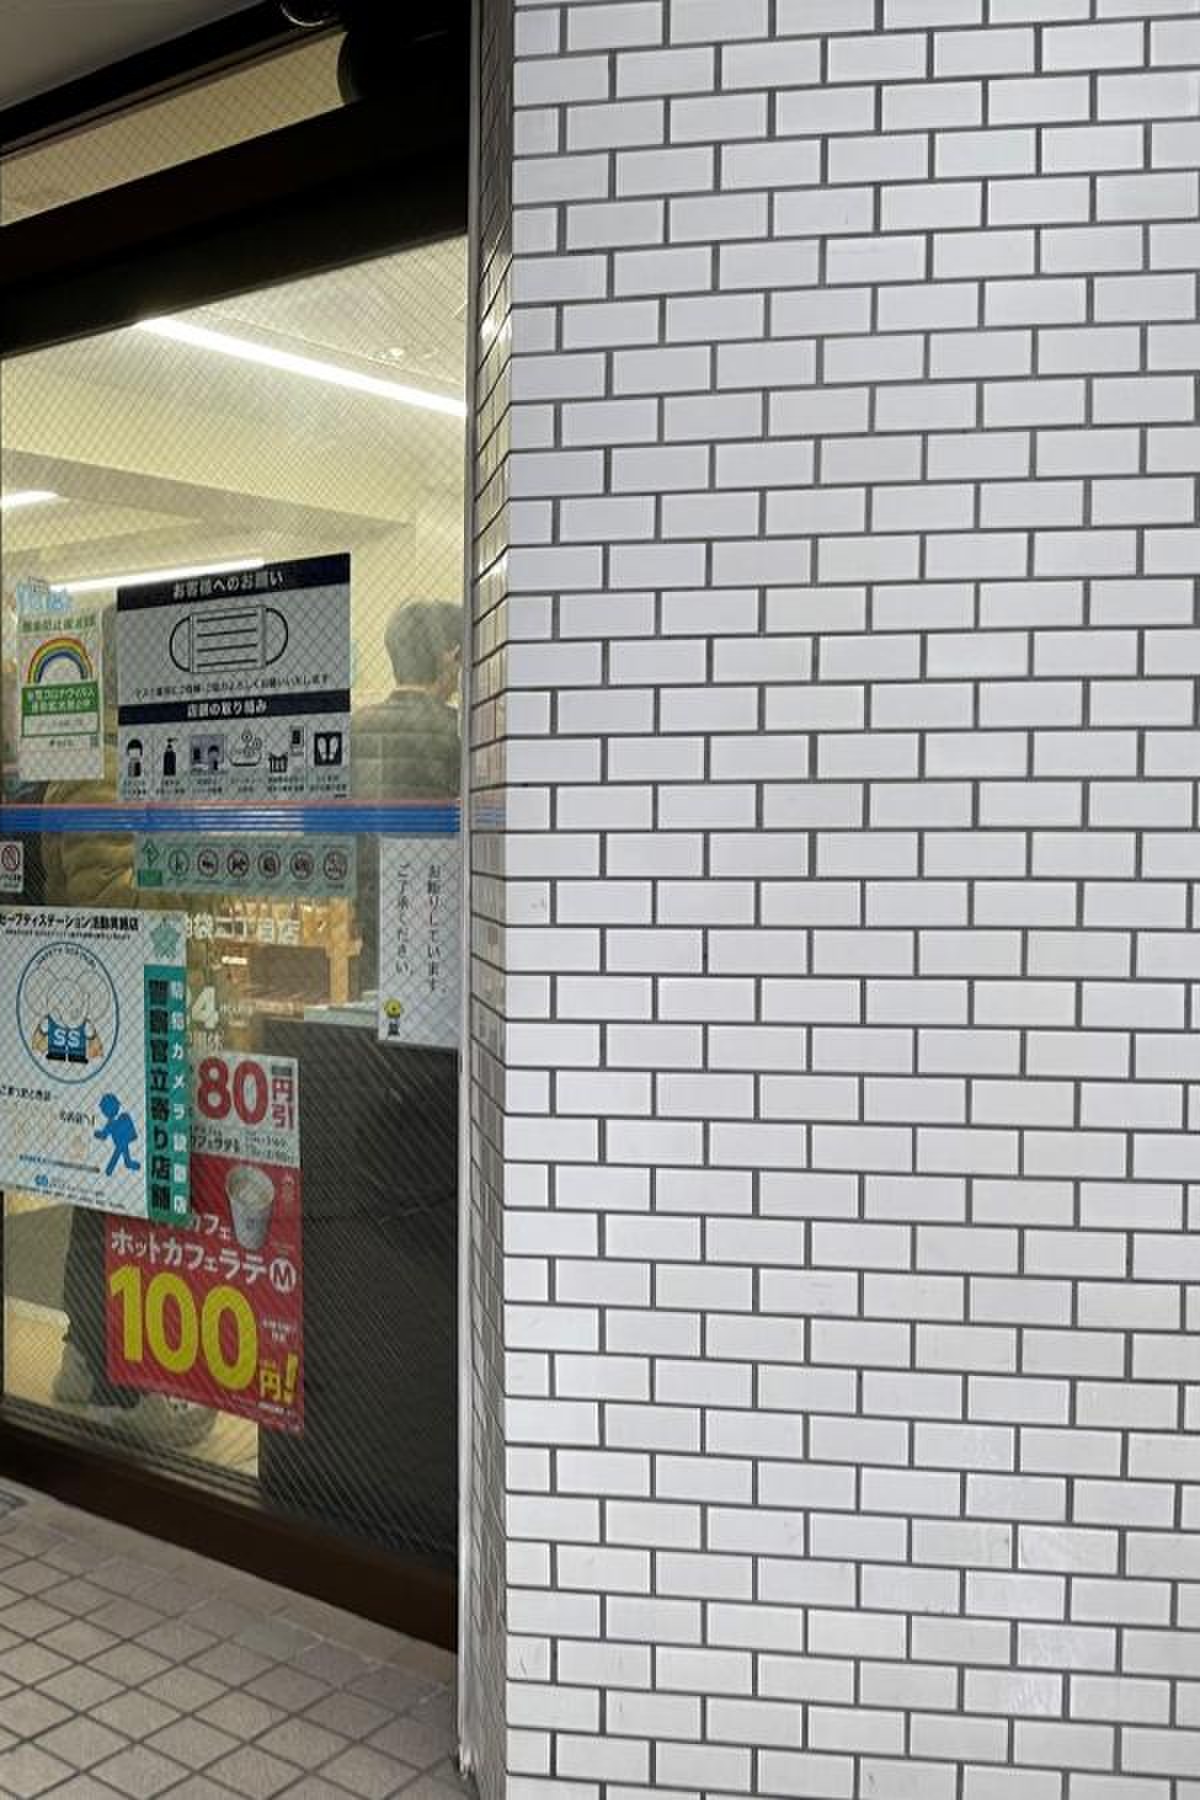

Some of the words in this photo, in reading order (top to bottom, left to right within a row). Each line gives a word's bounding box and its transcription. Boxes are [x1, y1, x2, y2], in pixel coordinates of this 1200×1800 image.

[172, 571, 284, 600] お客様へのお願い
[52, 1028, 82, 1049] SS
[197, 1056, 268, 1125] 80
[111, 1228, 267, 1284] ホットカフェラテ
[110, 1264, 258, 1390] 100
